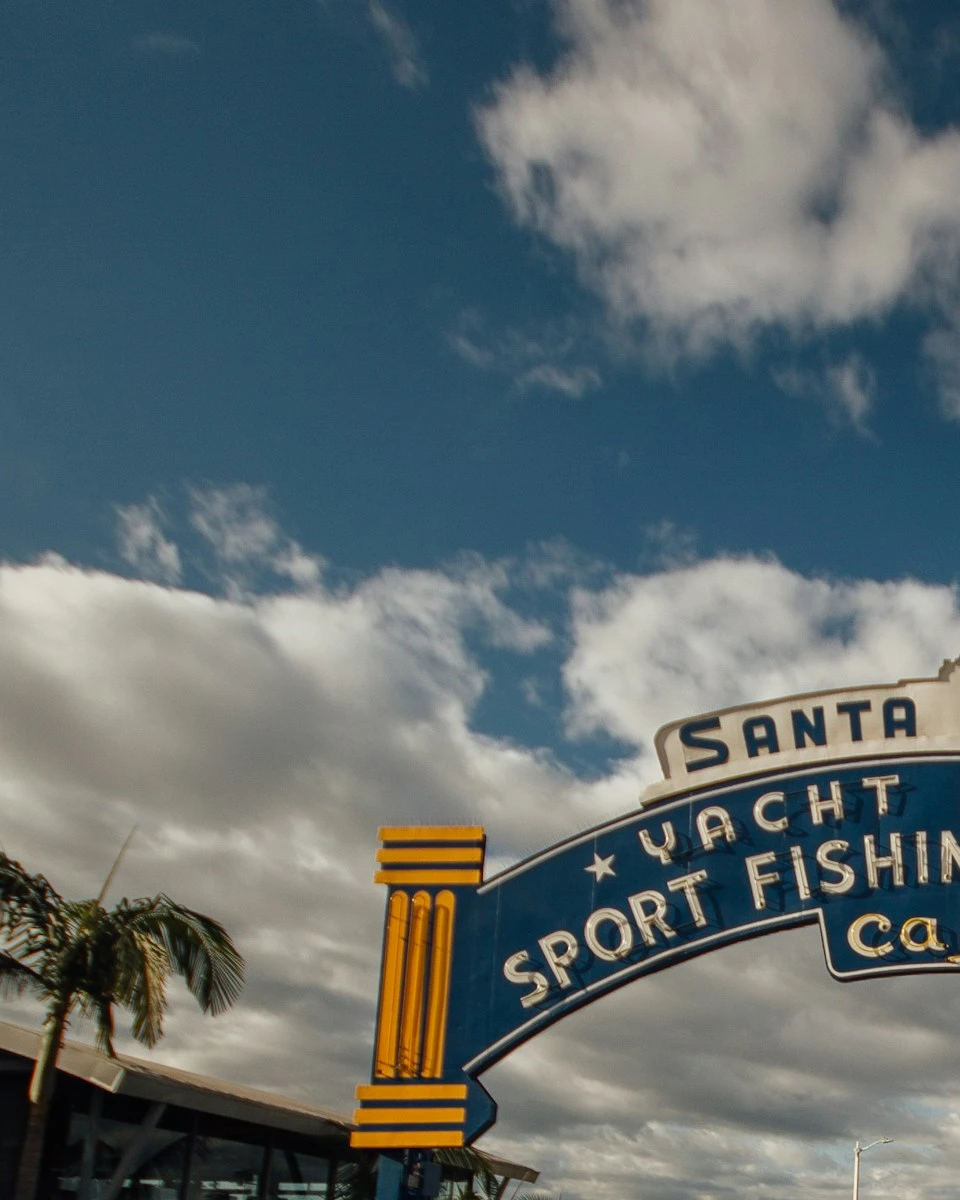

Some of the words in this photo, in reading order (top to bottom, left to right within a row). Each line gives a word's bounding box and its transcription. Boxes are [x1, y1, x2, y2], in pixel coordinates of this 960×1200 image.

[678, 696, 917, 773] SANTA
[638, 774, 901, 866] YACHT
[502, 870, 709, 1009] SPORT
